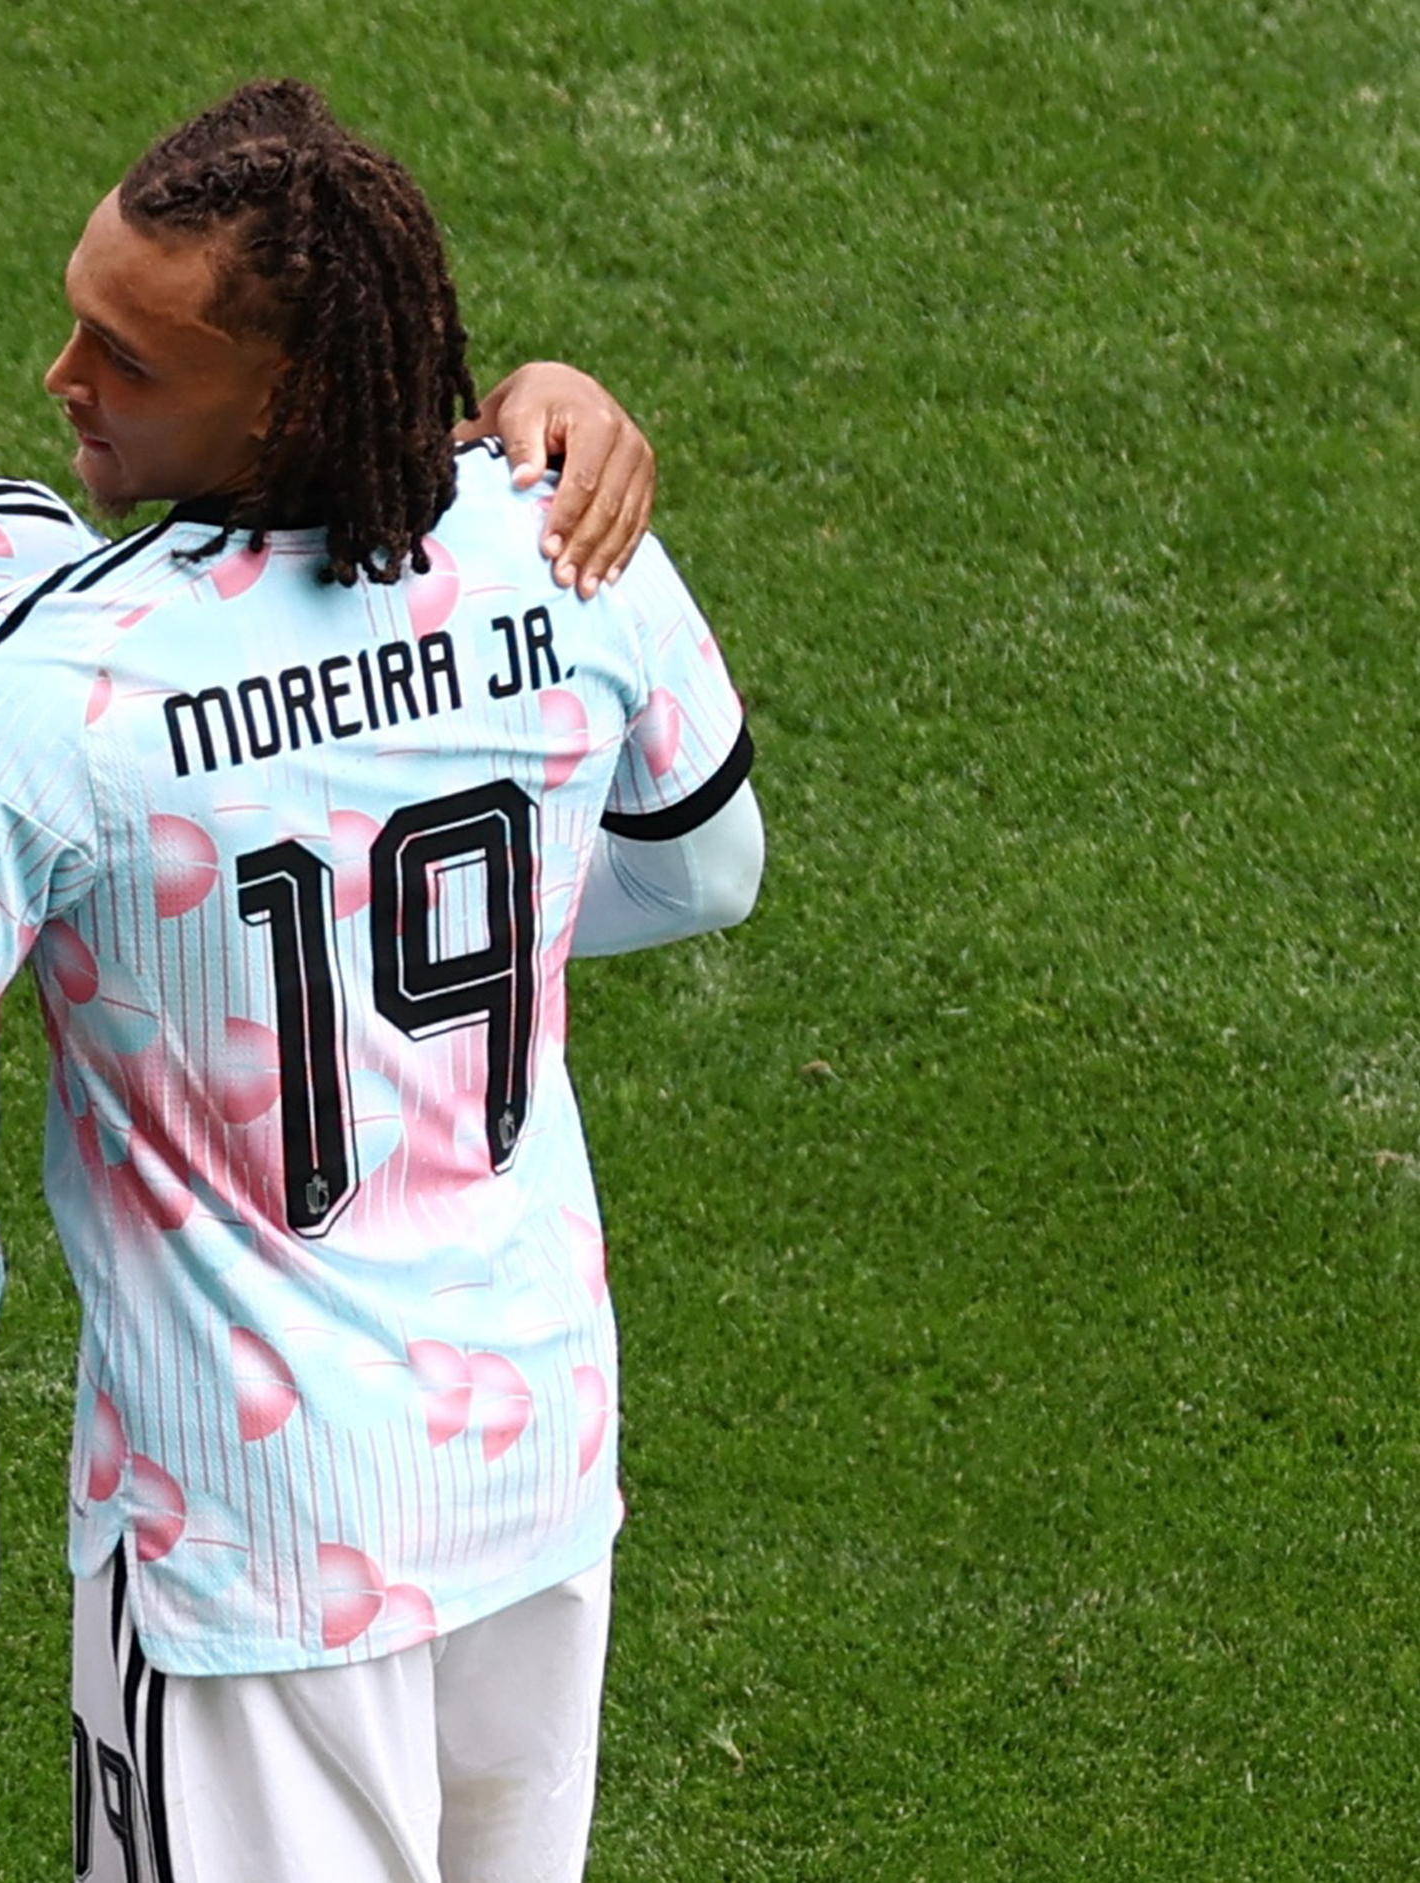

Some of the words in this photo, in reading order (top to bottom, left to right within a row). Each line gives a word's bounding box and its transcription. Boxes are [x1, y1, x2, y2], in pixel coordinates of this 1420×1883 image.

[164, 631, 462, 777] MOREIRA
[488, 606, 576, 699] JR.
[236, 779, 541, 1239] 19
